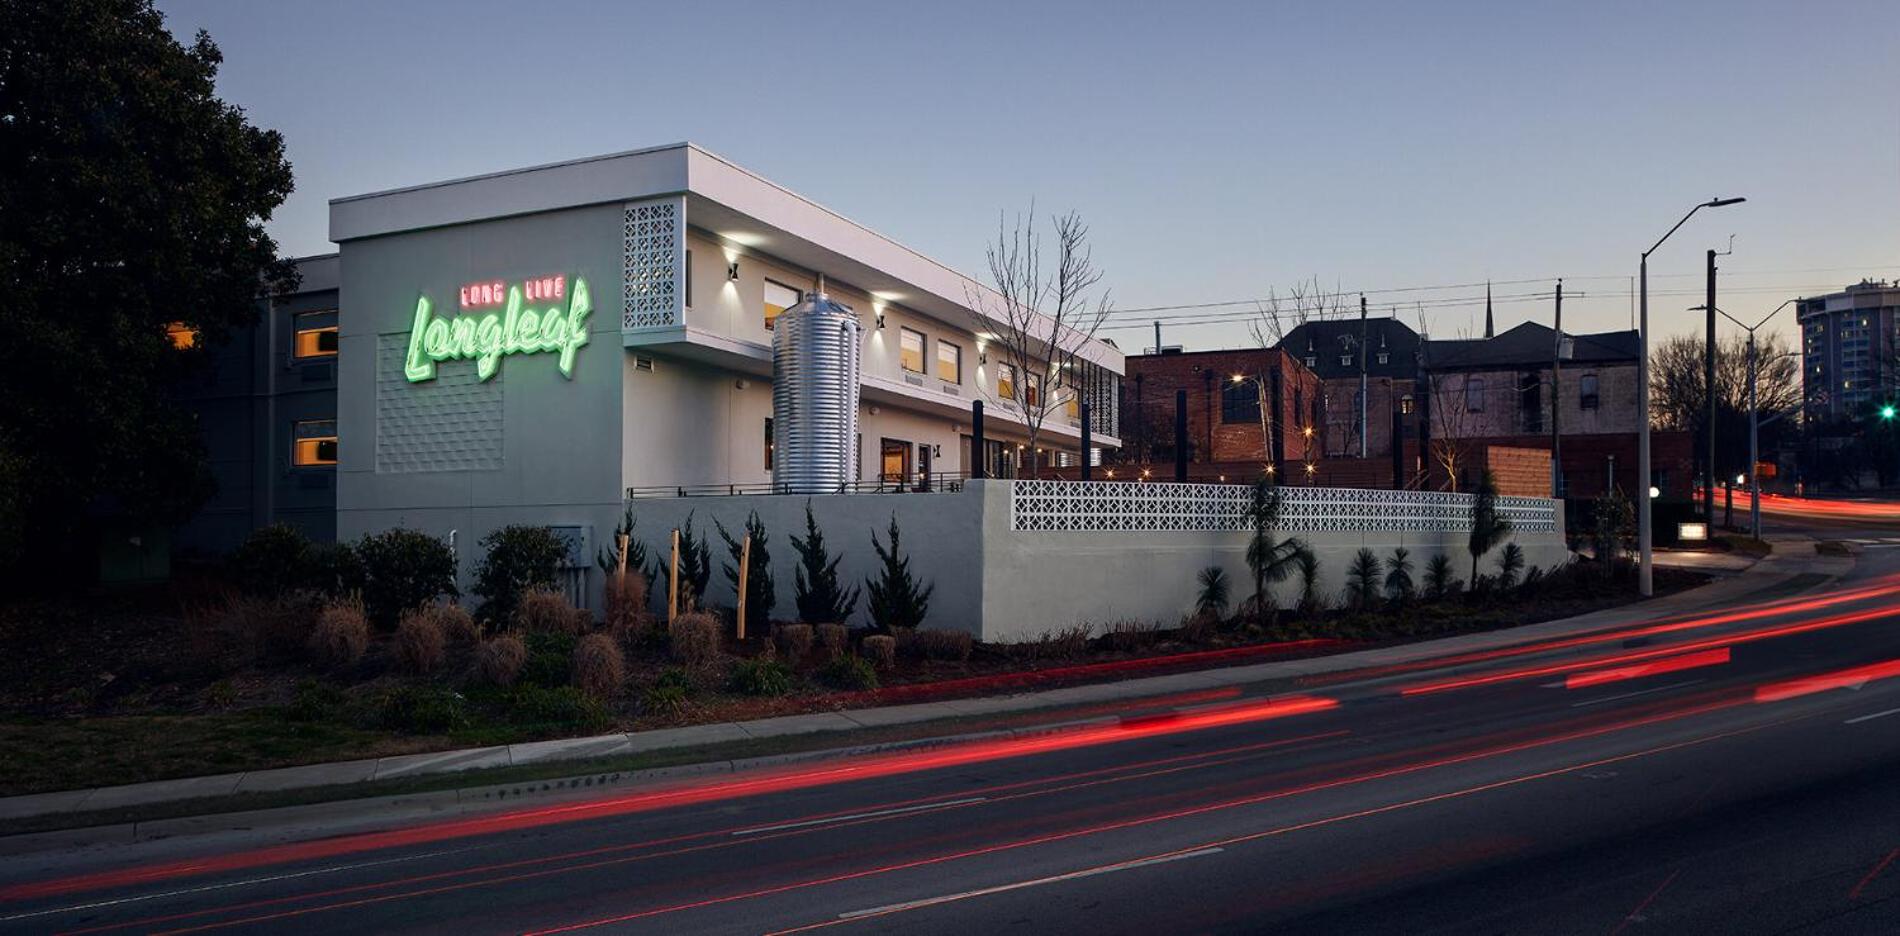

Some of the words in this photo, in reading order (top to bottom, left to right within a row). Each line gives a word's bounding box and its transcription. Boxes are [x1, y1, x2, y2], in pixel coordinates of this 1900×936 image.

[460, 283, 504, 306] LONG
[525, 276, 564, 300] LIVE
[405, 278, 591, 382] Longleaf
